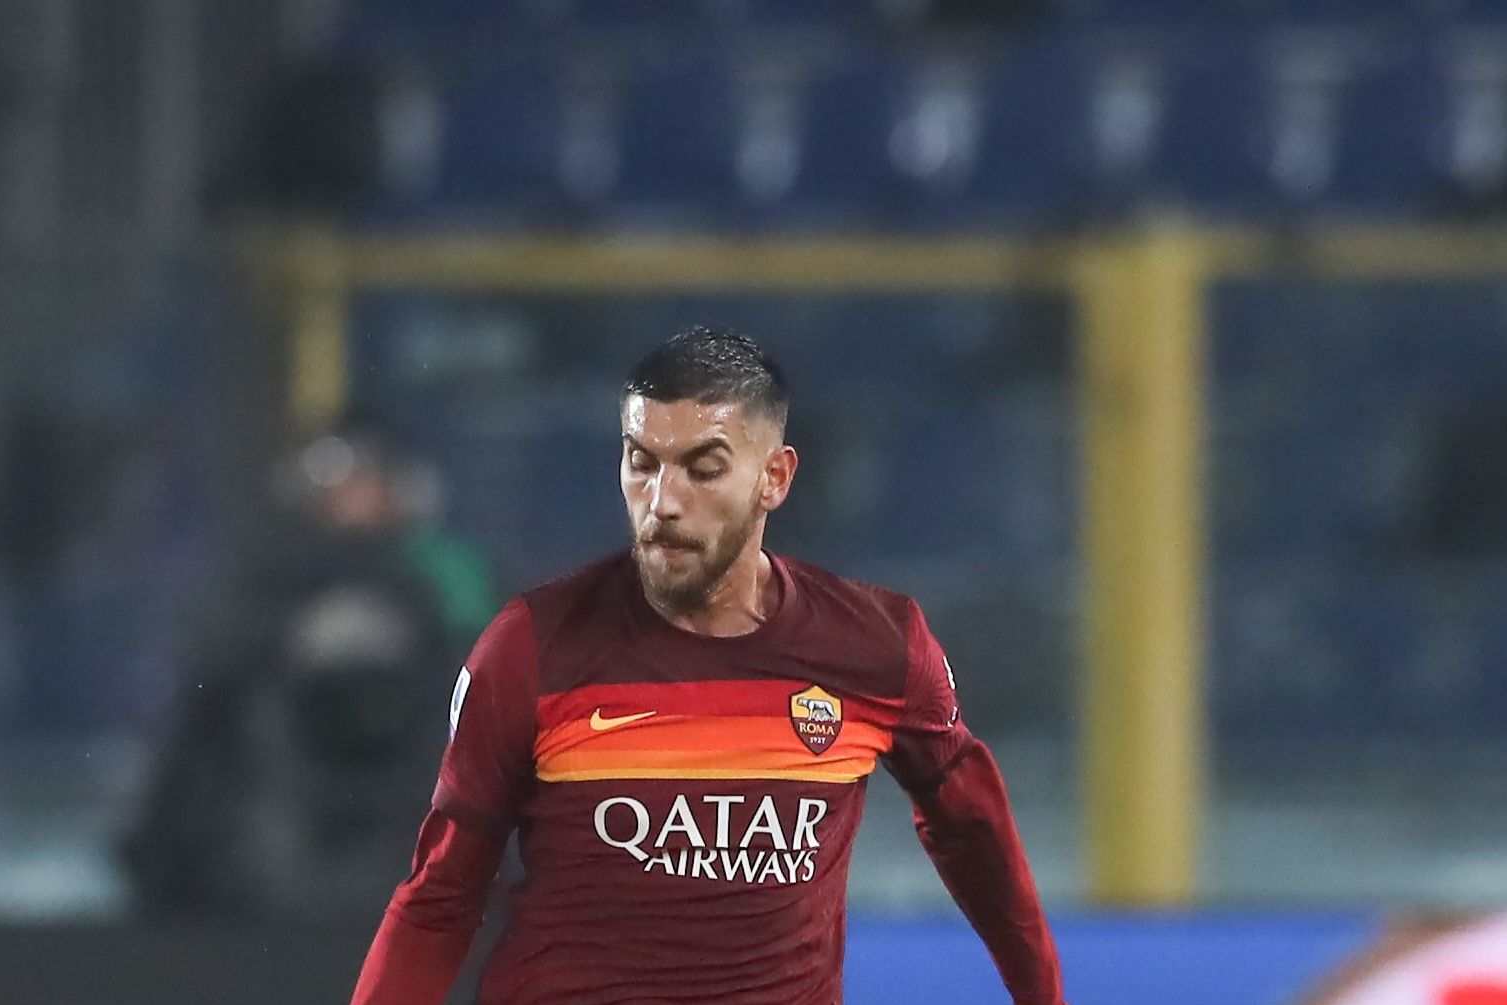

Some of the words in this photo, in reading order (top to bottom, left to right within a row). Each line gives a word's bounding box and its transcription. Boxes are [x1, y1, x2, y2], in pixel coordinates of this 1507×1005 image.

[799, 722, 835, 735] ROMA
[594, 794, 827, 861] QATAR
[644, 849, 818, 884] AIRWAYS
